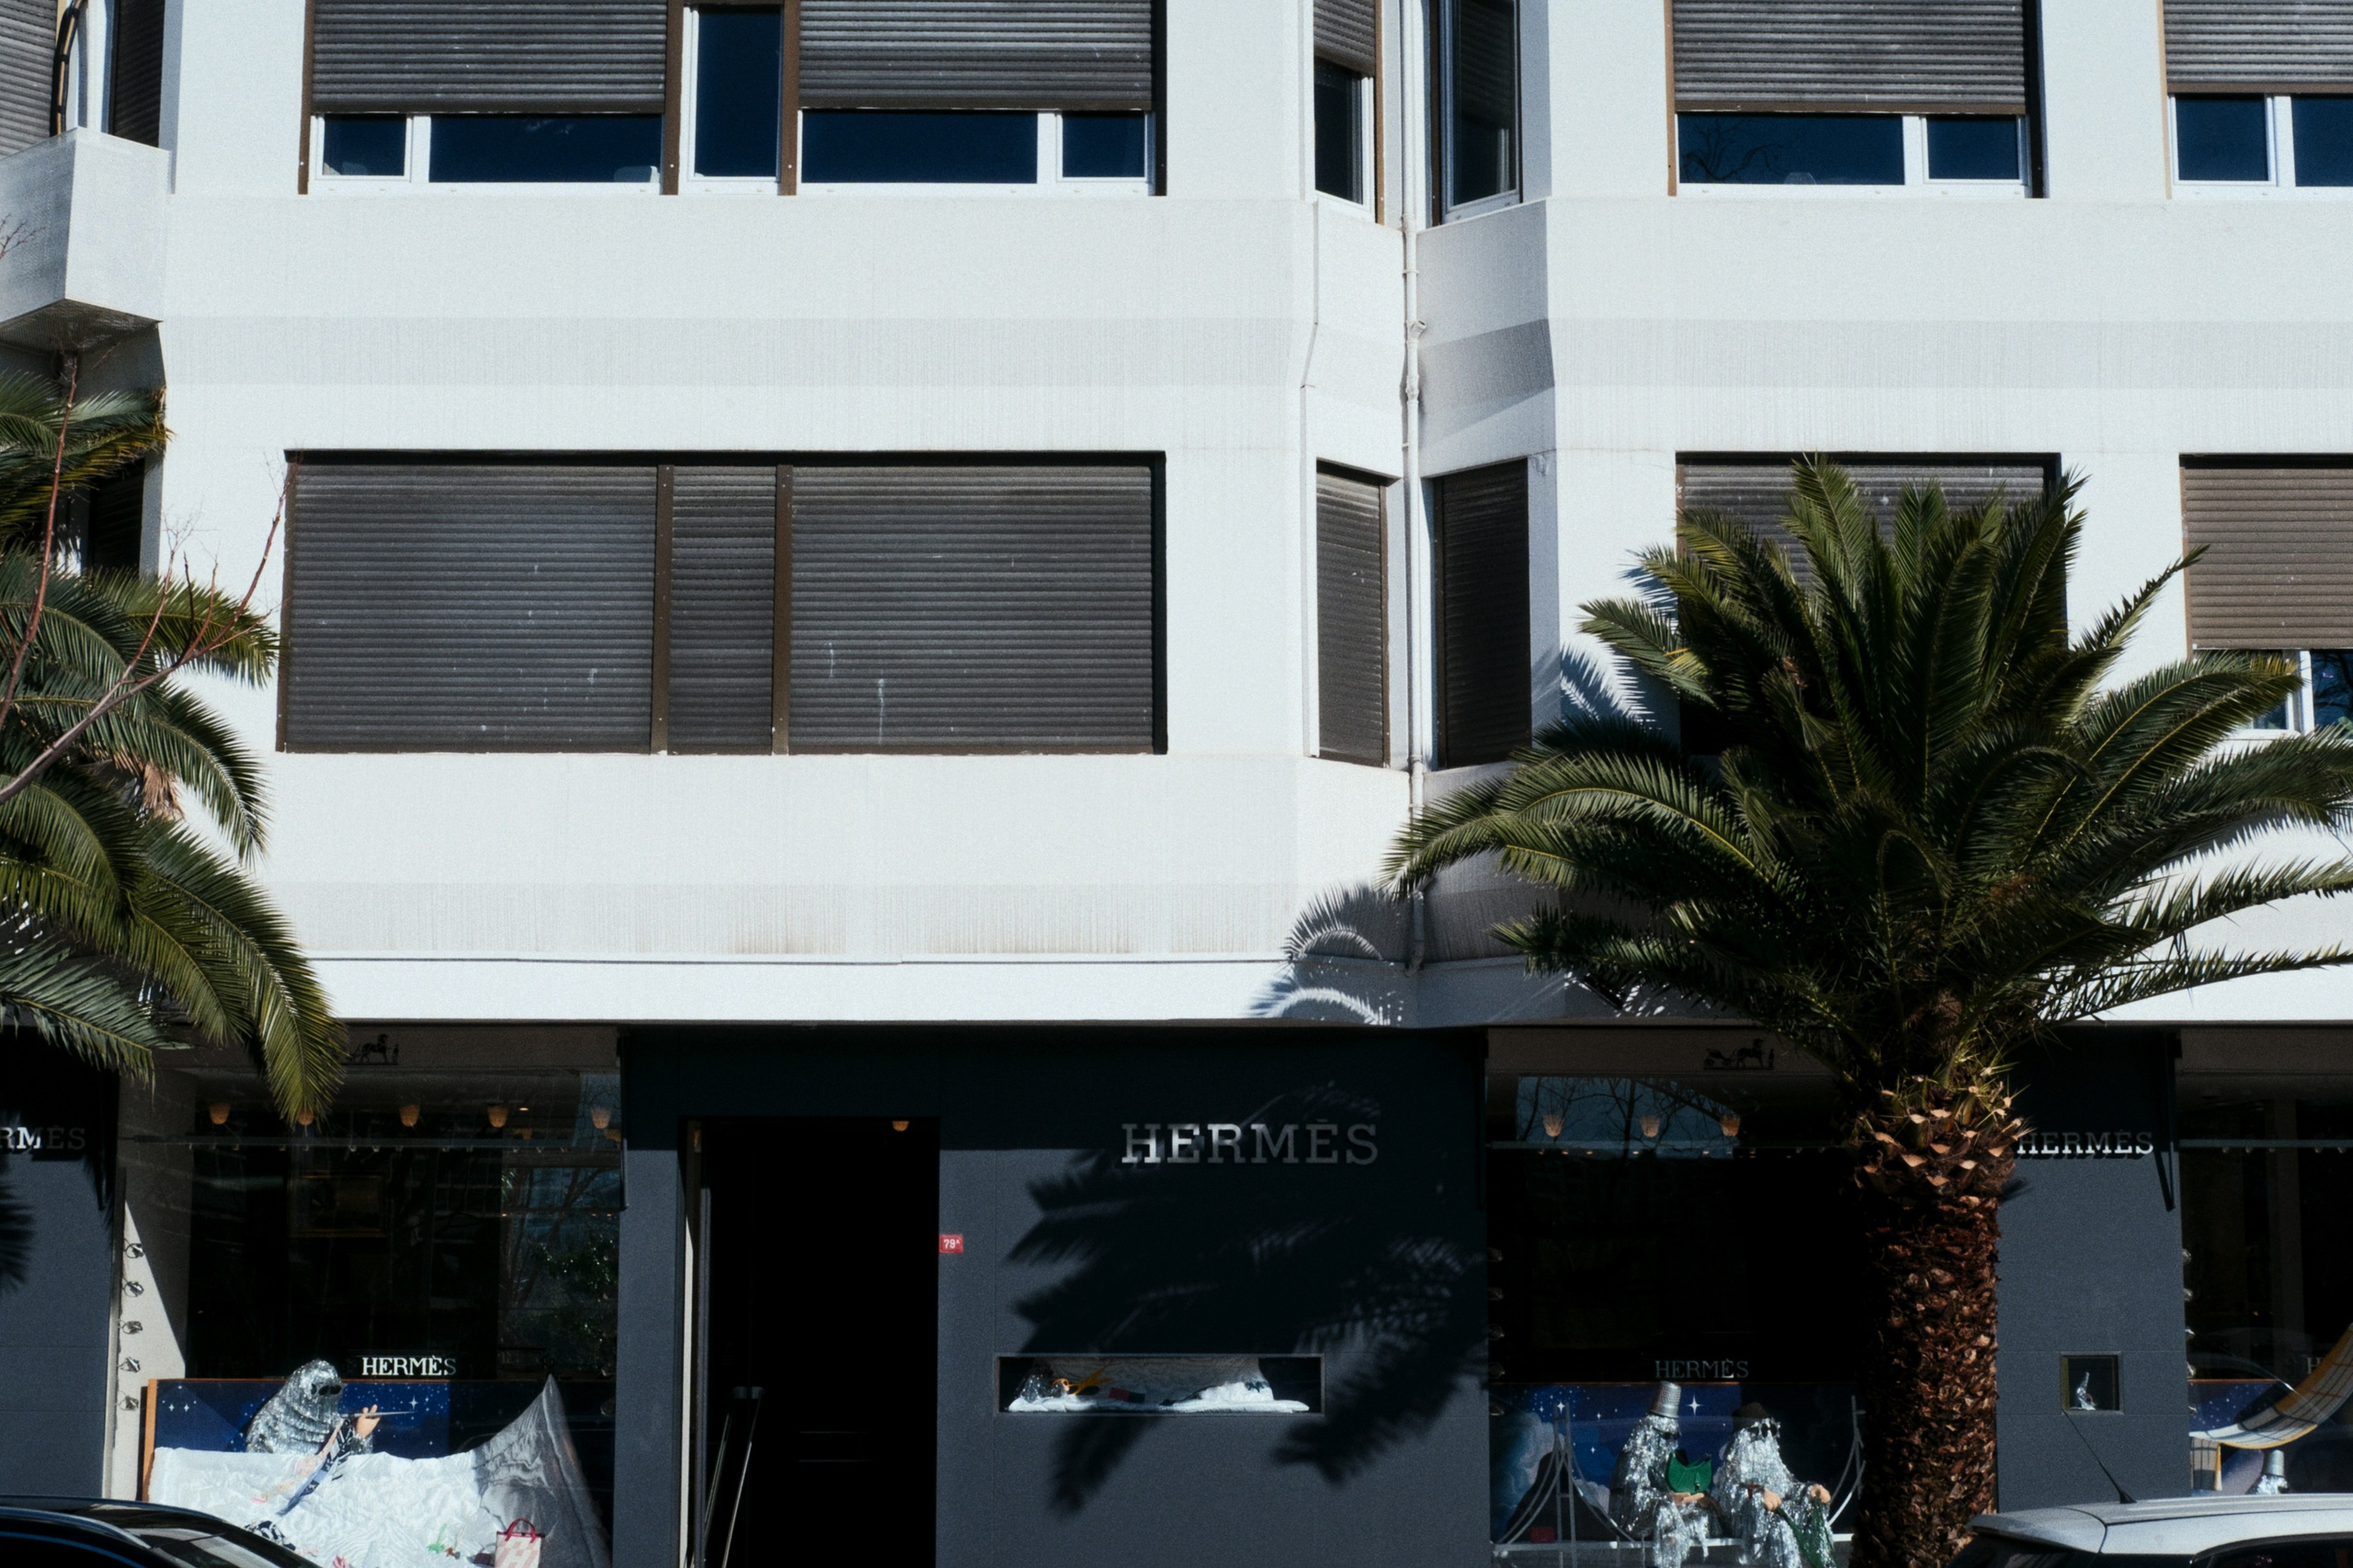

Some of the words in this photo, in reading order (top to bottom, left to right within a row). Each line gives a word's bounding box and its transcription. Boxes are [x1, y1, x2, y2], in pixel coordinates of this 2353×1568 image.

[1120, 1118, 1378, 1165] HERMÈS
[2017, 1129, 2154, 1155] HERMÈS
[361, 1355, 457, 1376] HERMÈS
[1654, 1358, 1749, 1379] HERMÈS
